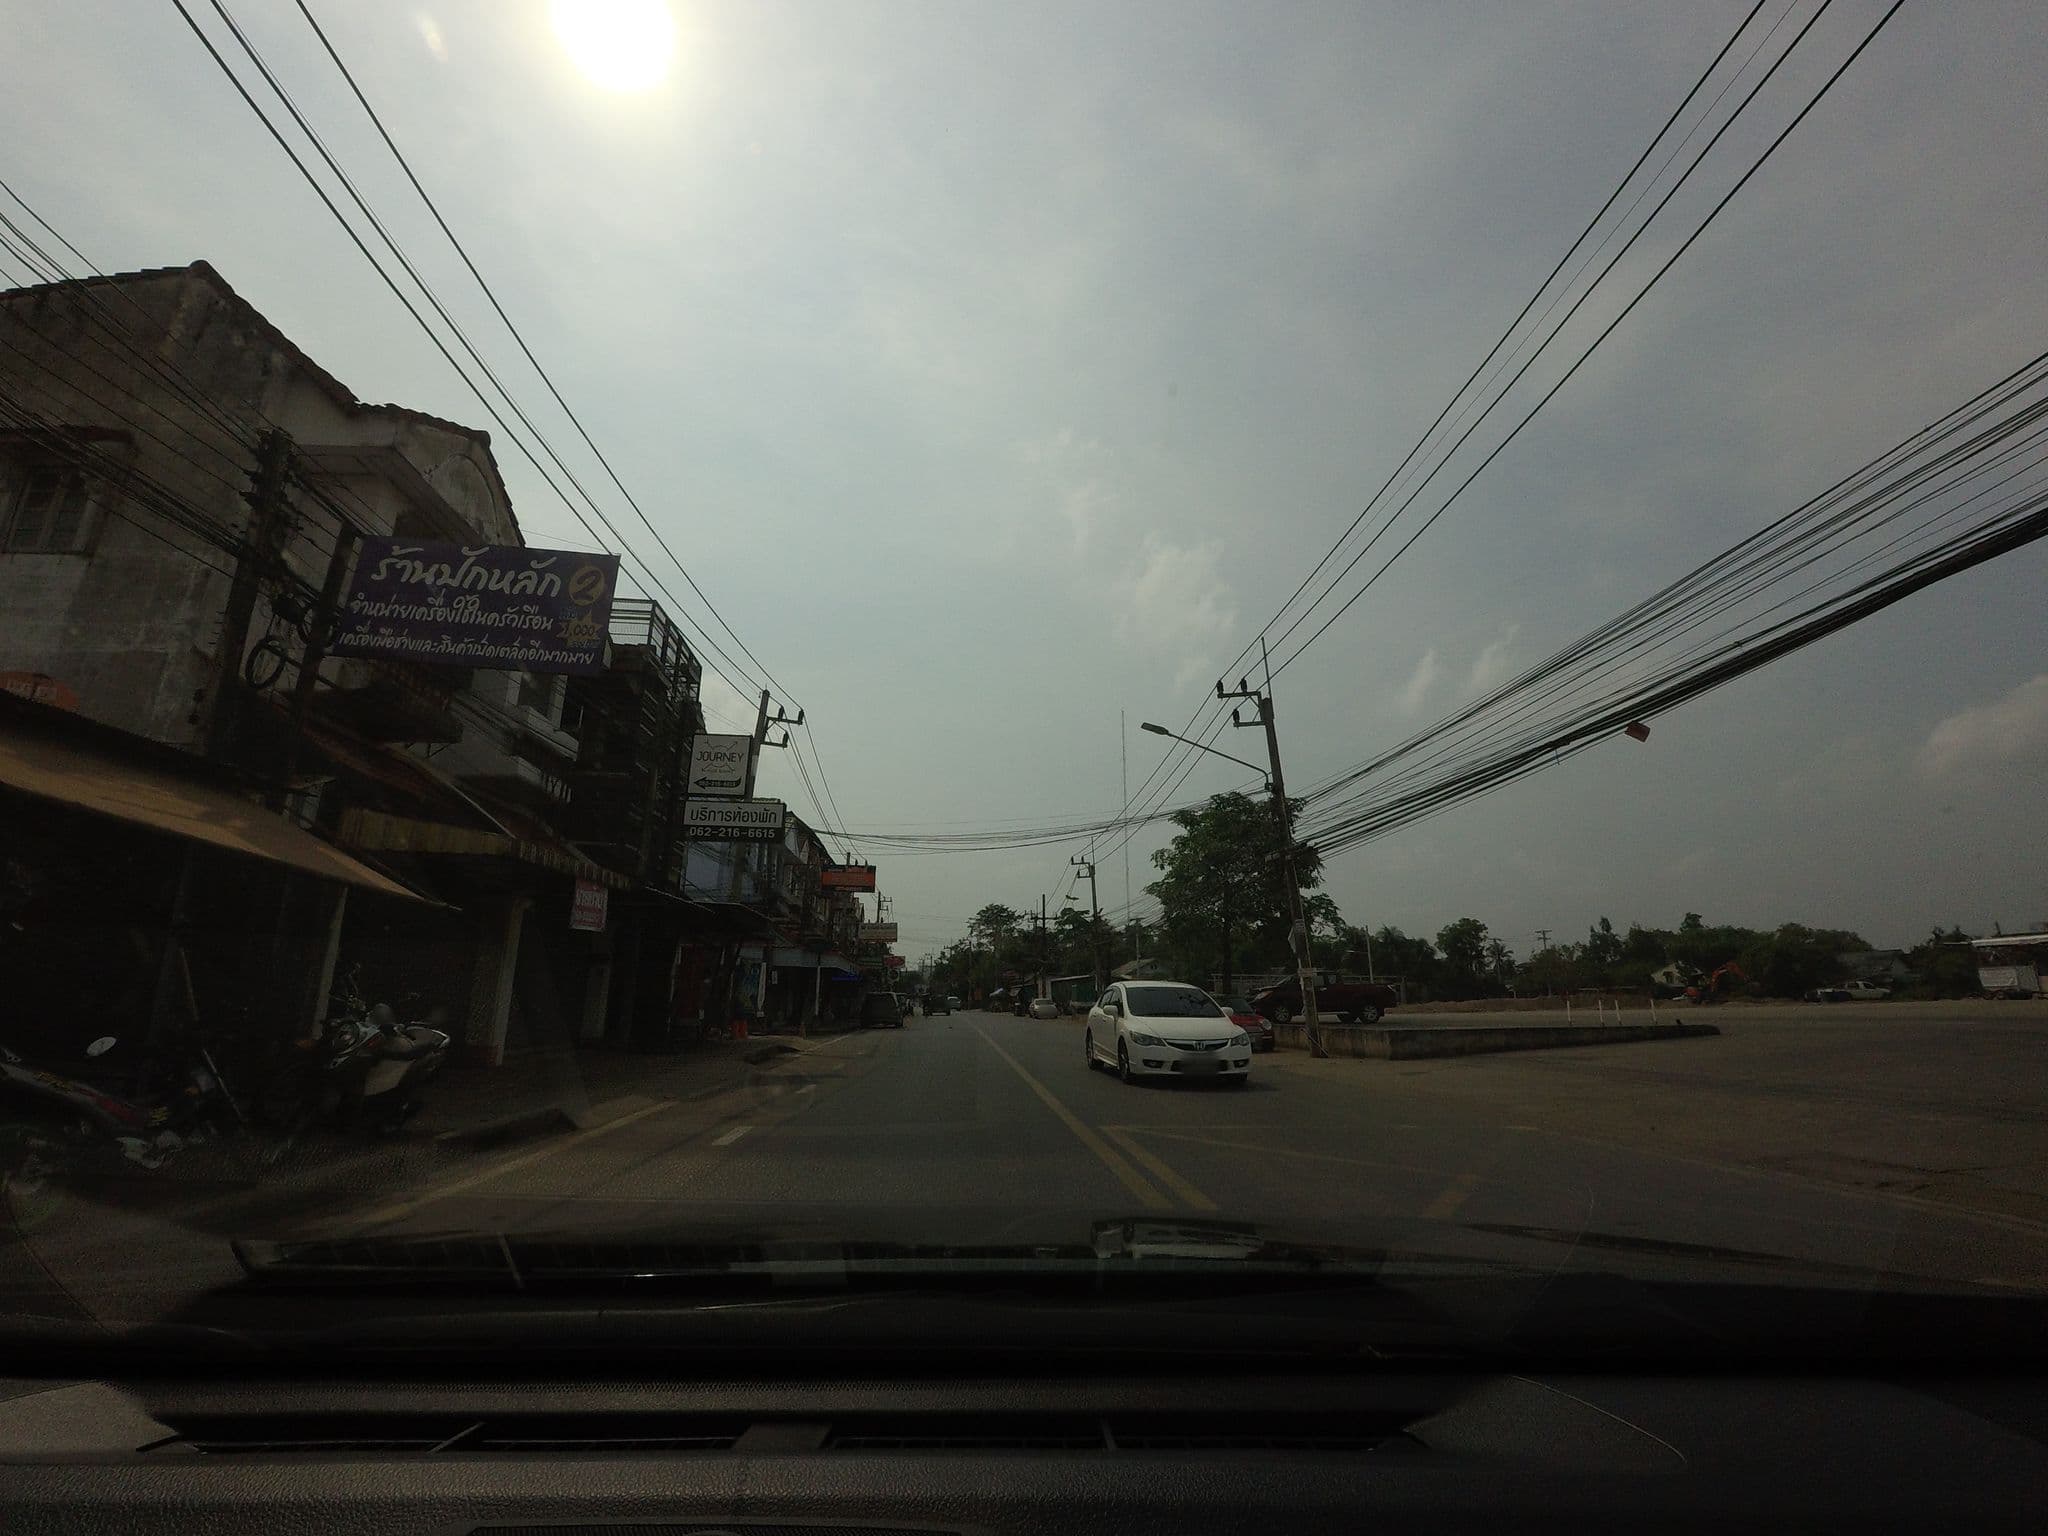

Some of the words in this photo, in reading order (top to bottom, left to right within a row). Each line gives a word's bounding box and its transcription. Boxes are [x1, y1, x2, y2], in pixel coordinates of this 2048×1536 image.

[370, 545, 561, 597] ร้านปักหลัก
[696, 752, 744, 763] JOURNEY
[690, 806, 777, 823] บริการห้องพัก
